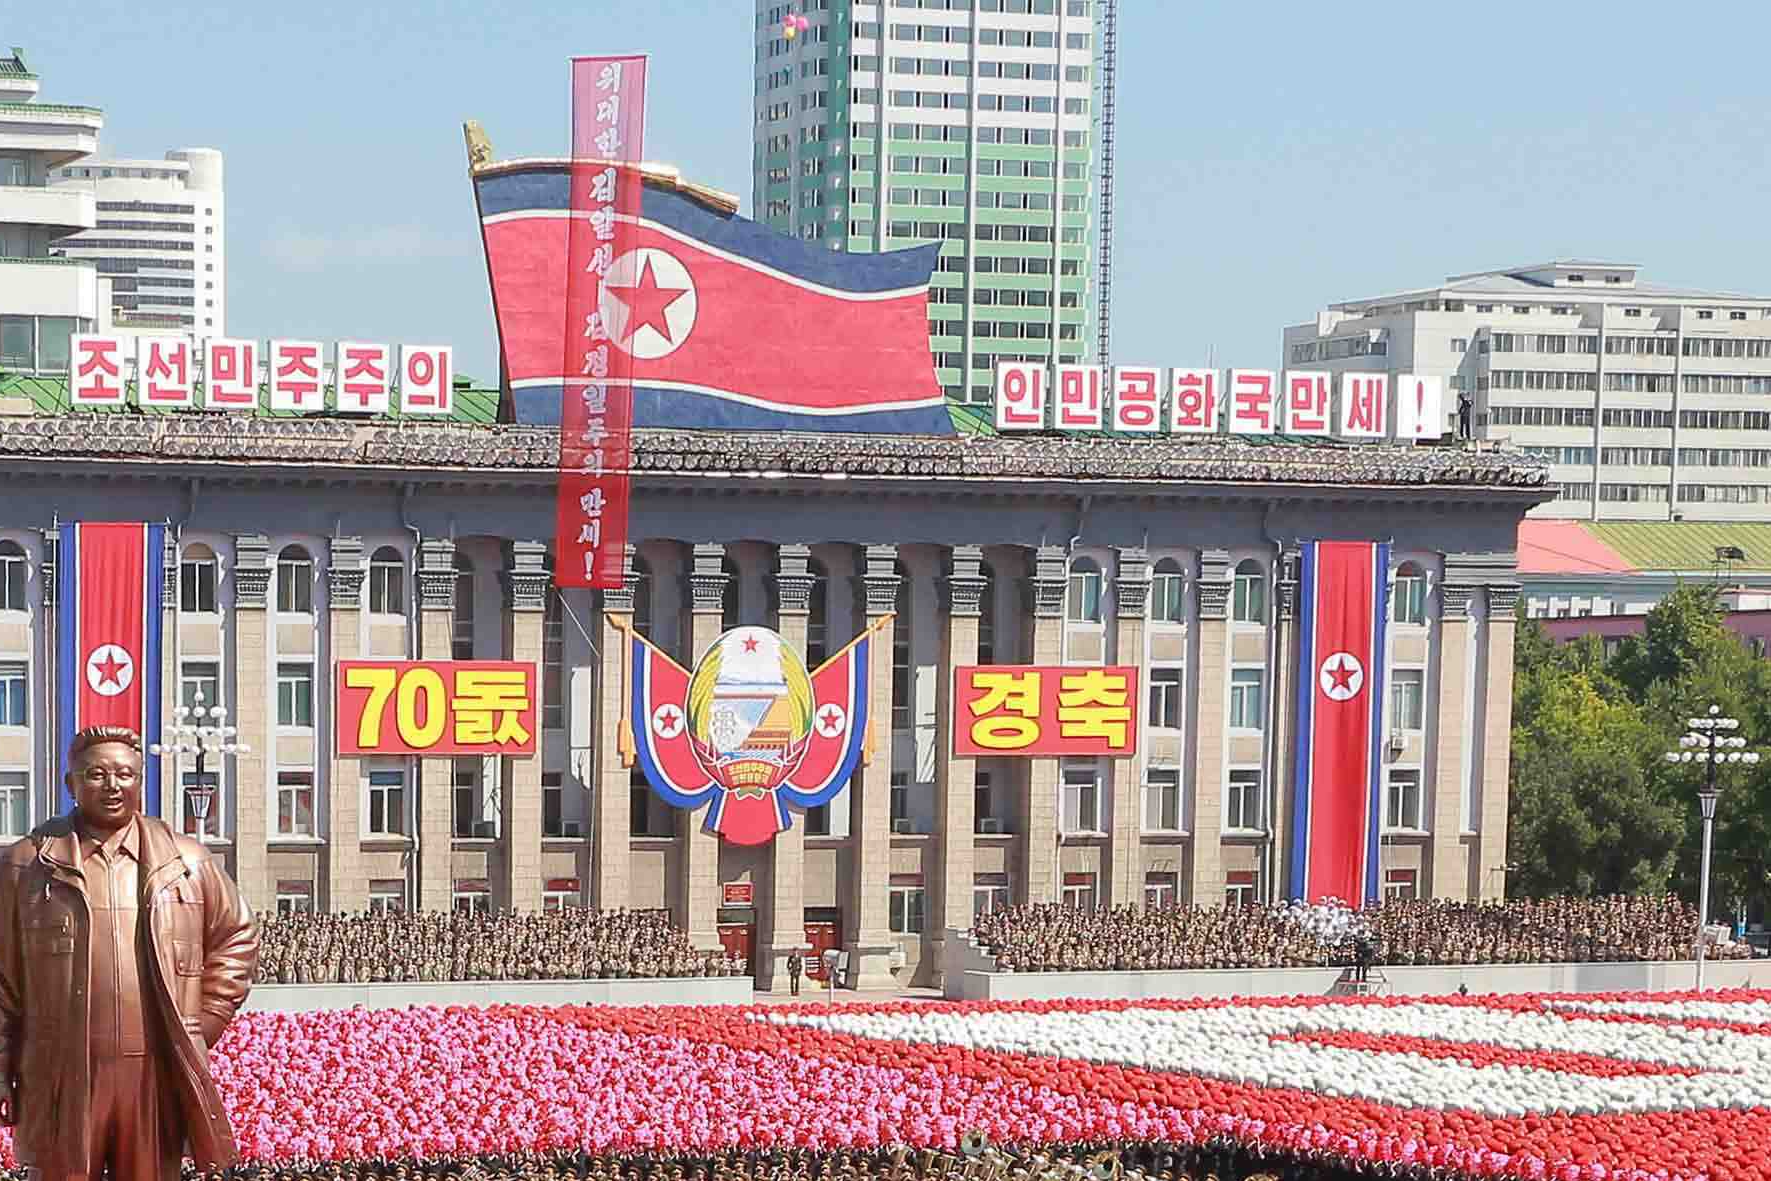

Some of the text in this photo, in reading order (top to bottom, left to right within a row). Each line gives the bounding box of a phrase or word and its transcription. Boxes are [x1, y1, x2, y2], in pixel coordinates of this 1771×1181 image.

[593, 61, 624, 158] 위대한
[78, 340, 448, 409] 조선민주주의
[576, 487, 606, 581] 만세!
[345, 667, 532, 749] 70돐
[968, 670, 1132, 750] 경축
